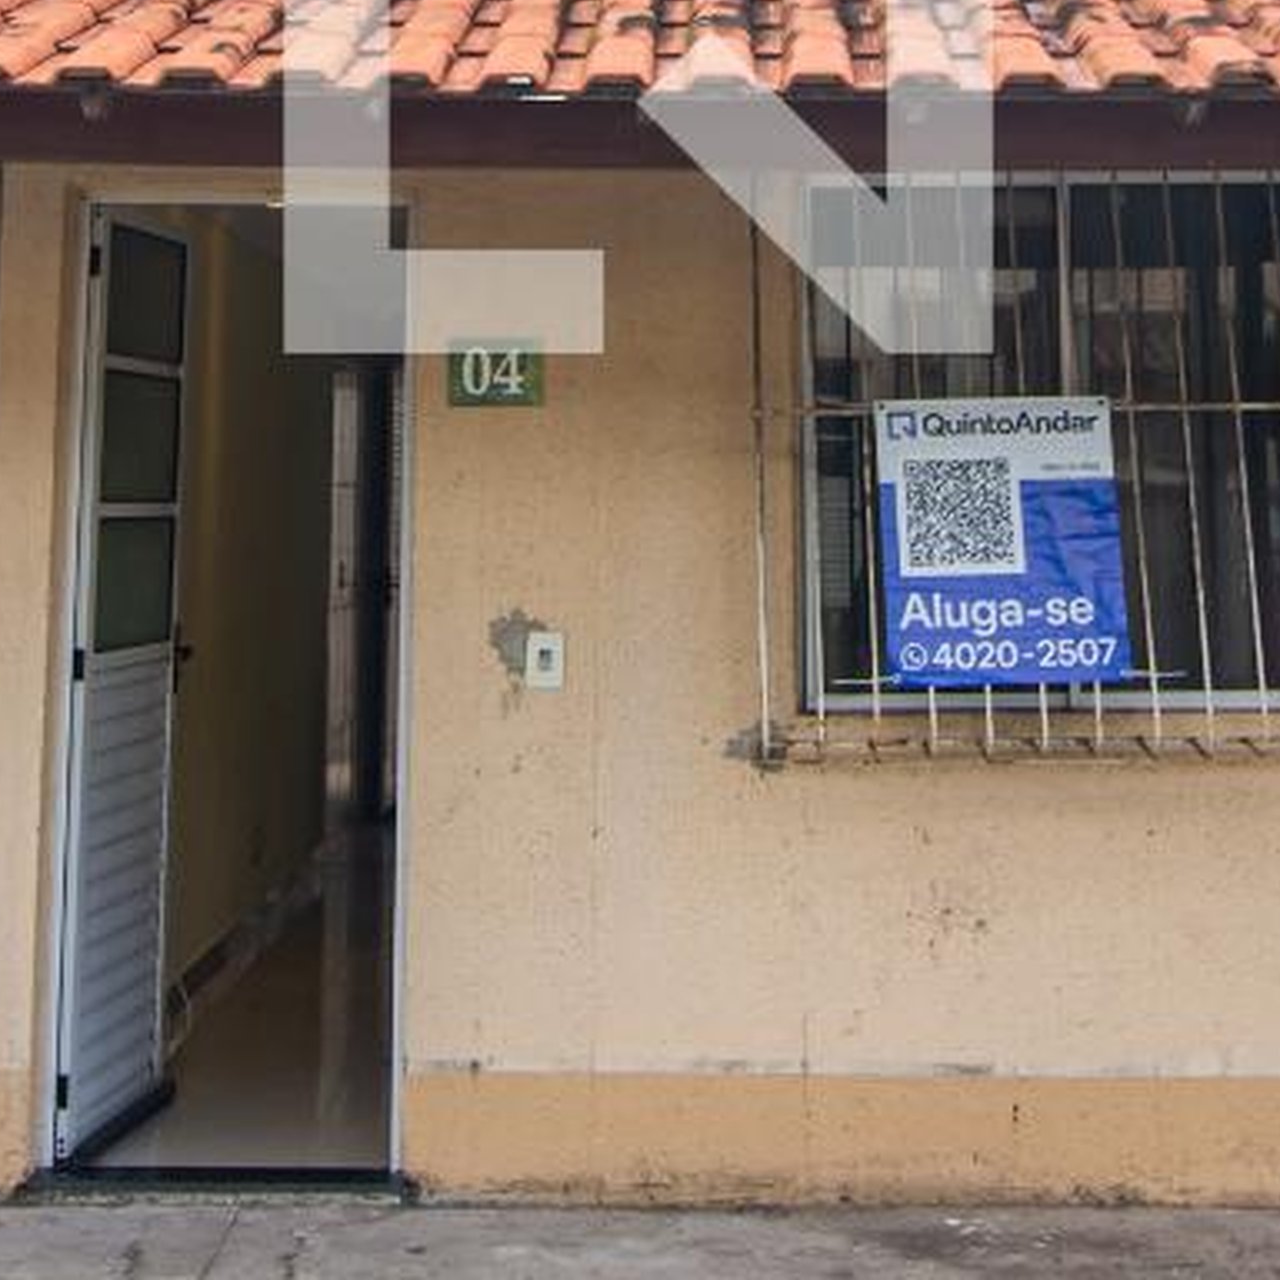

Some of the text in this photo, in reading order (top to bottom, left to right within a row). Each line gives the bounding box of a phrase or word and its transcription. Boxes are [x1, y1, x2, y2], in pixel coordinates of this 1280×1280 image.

[462, 346, 524, 395] 04
[922, 410, 1099, 437] QuintoAndar
[899, 592, 1095, 637] Aluga-se
[931, 637, 1118, 669] 4020-2507
